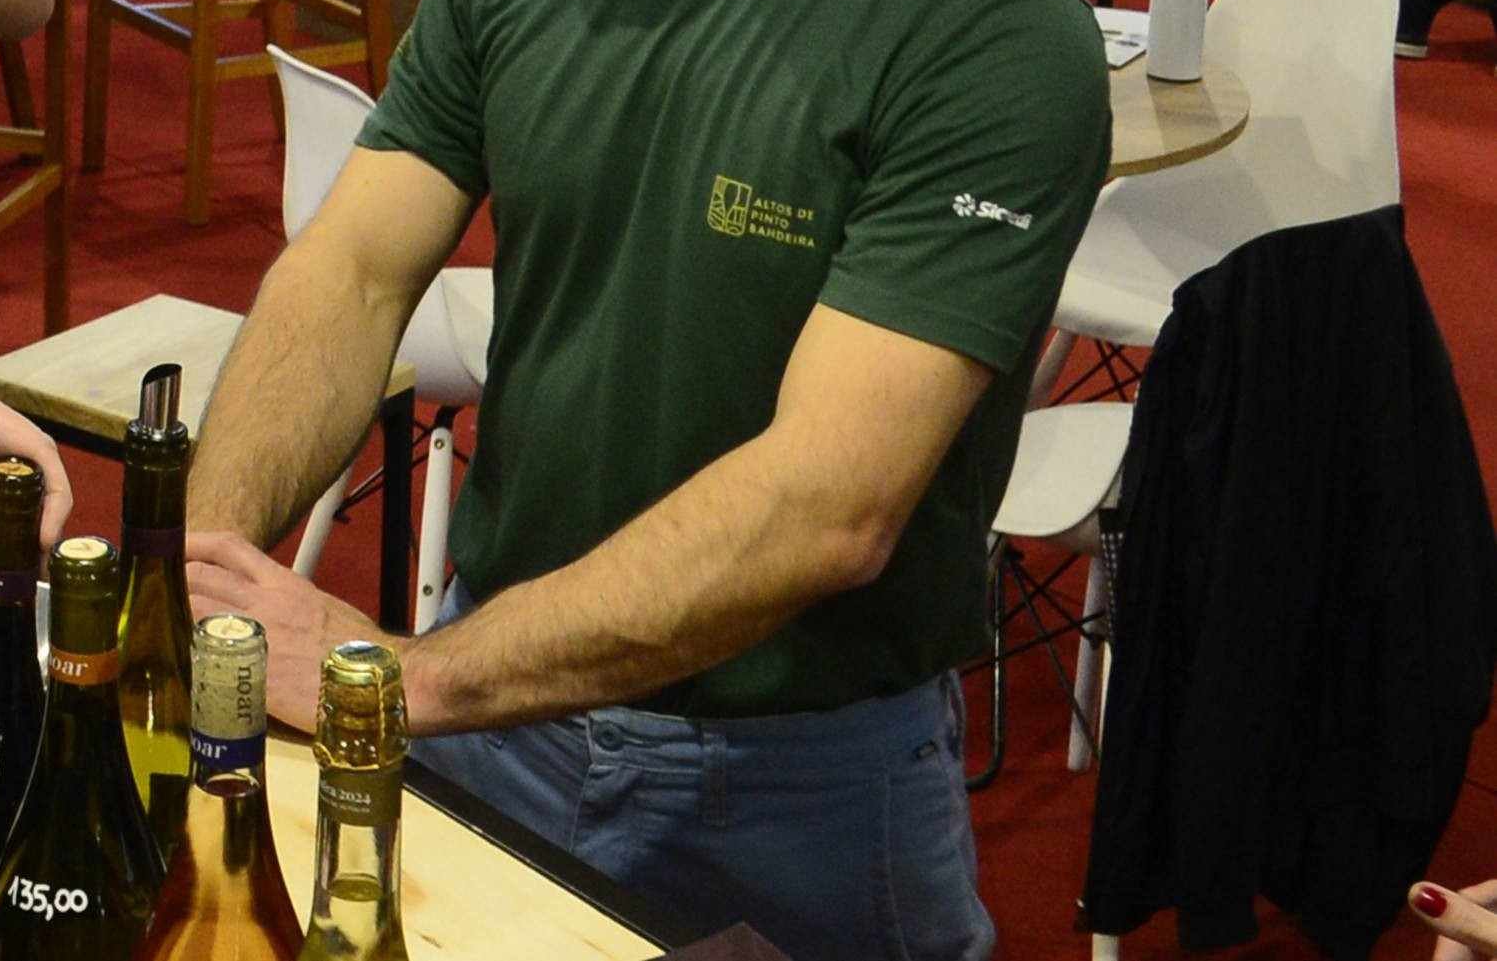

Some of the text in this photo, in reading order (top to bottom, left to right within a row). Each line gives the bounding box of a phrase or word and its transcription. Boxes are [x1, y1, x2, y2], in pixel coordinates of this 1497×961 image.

[750, 208, 790, 230] PINTO
[752, 197, 815, 221] ALTOS DE
[748, 222, 815, 248] BANDEIRA
[50, 655, 89, 677] oar
[236, 666, 253, 725] noar
[191, 736, 228, 759] oar
[7, 875, 89, 922] 135,00
